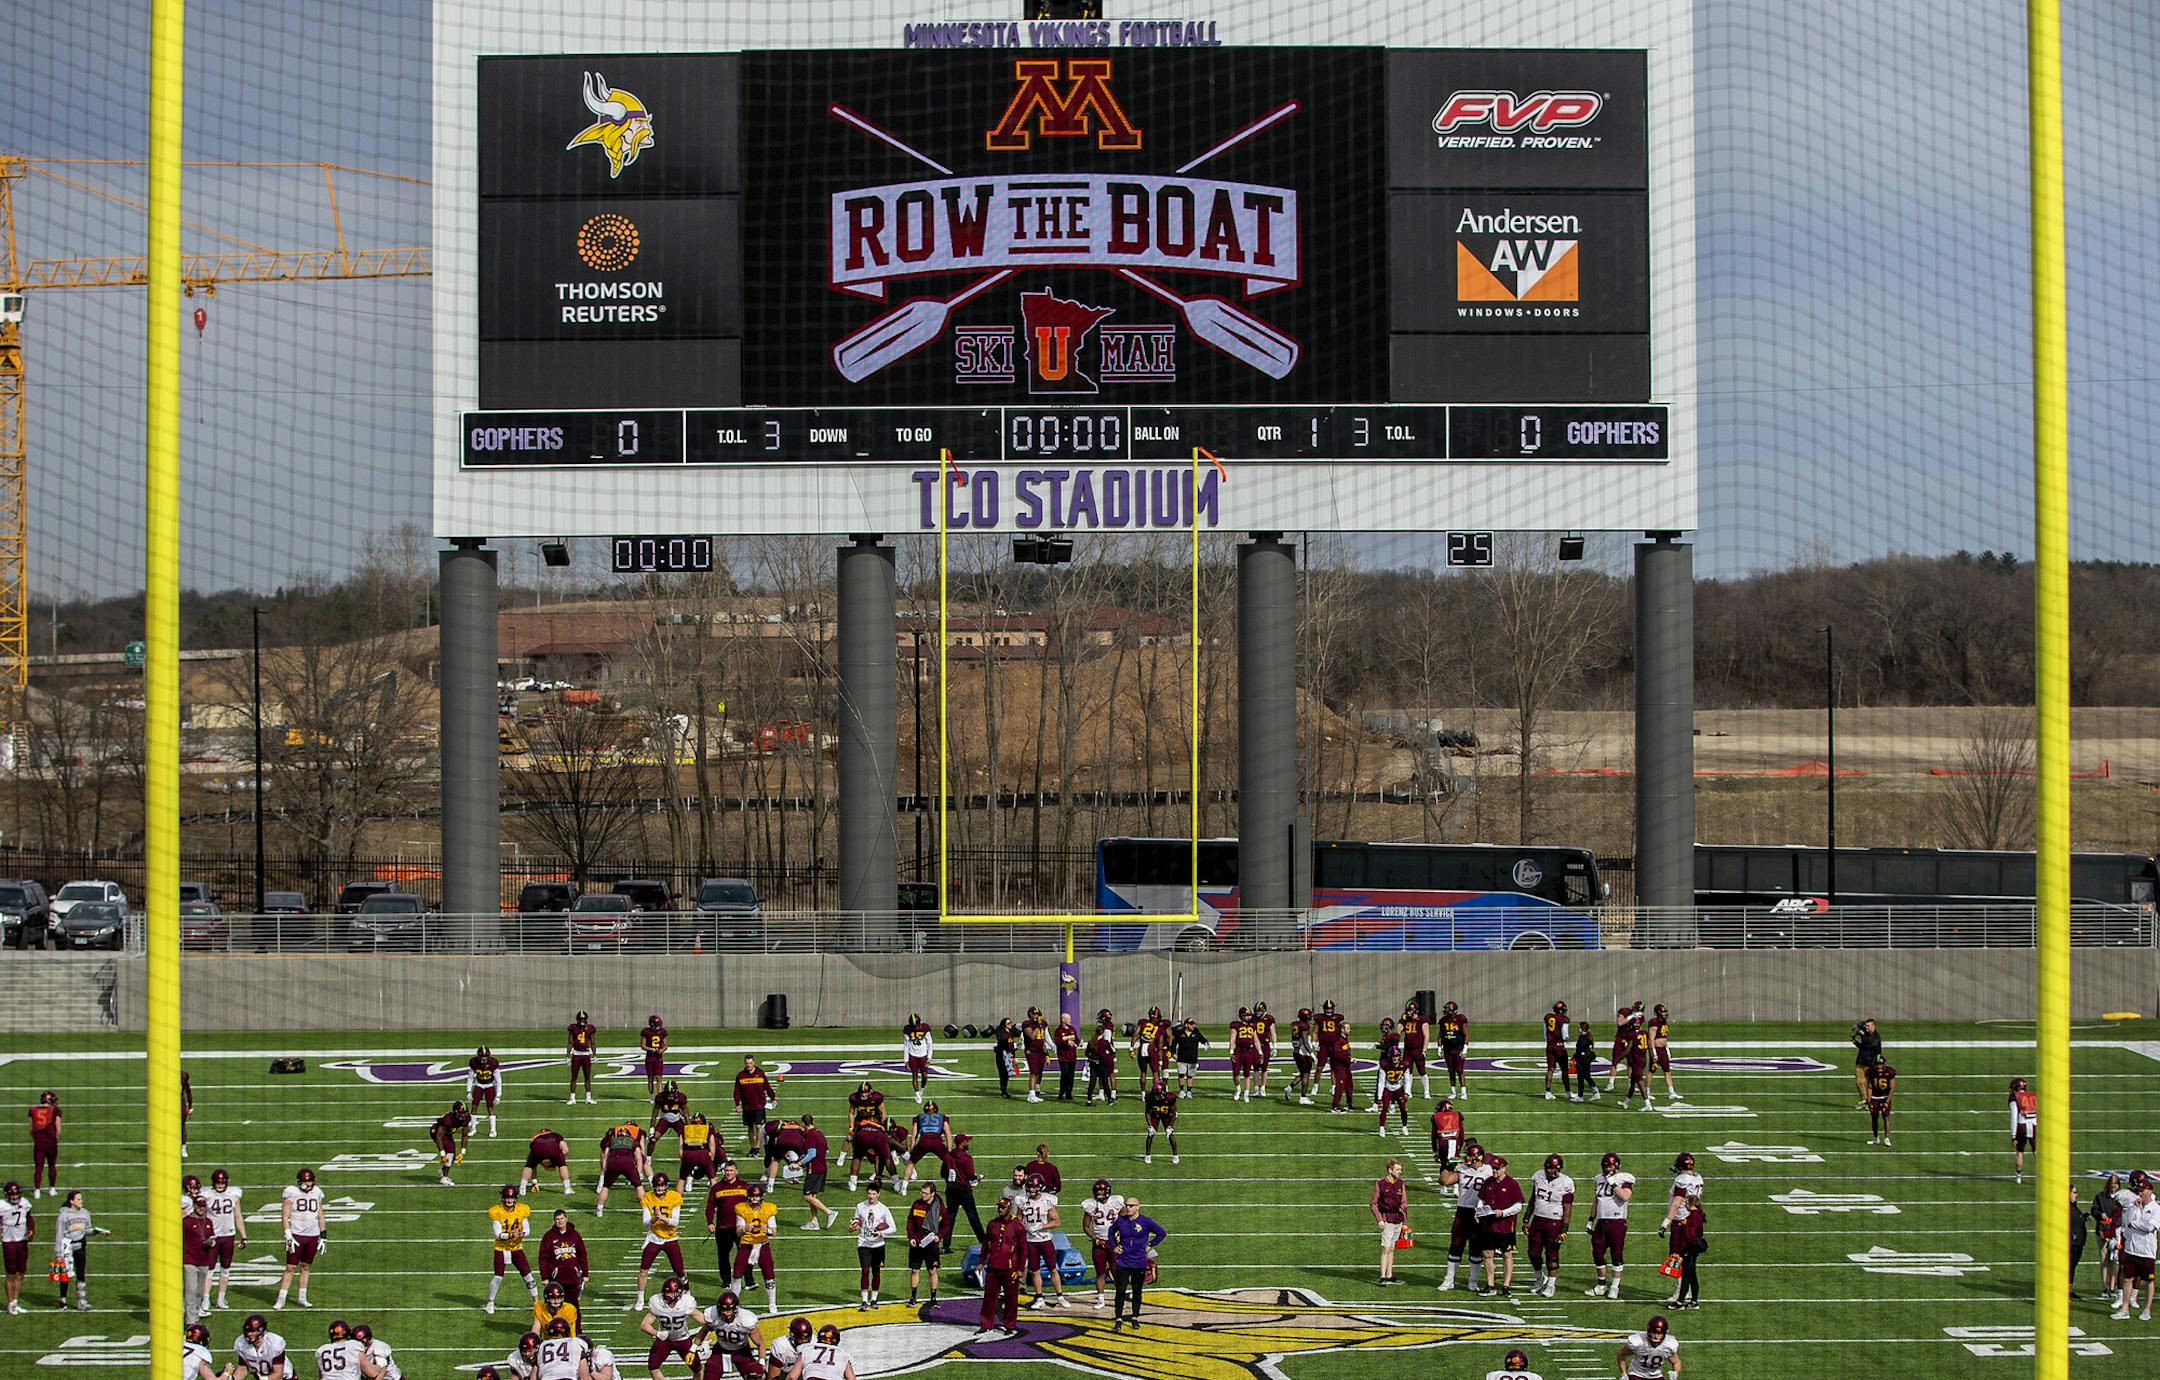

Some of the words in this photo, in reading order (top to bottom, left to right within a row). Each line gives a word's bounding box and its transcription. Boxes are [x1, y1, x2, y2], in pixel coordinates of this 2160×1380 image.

[903, 22, 1021, 48] MINNESOTA
[1027, 21, 1111, 47] VIKINGS
[1119, 20, 1222, 47] FOOTBALL
[986, 60, 1142, 150] M
[1433, 90, 1603, 134] FVP
[1437, 136, 1516, 148] VERIFIED.
[844, 184, 994, 271] ROW
[1008, 196, 1090, 239] THE
[1107, 182, 1284, 267] BOAT
[1456, 208, 1579, 233] Andersen
[555, 282, 663, 300] THOMSON
[1457, 307, 1523, 317] WINDOWS
[1534, 307, 1580, 317] DOORS
[955, 336, 1015, 374] SKI
[1035, 327, 1071, 381] U
[1099, 335, 1176, 373] MAH
[471, 427, 563, 452] GOPHERS
[618, 420, 639, 456] 0
[716, 429, 747, 444] T.O.L.
[765, 420, 780, 450] 3
[810, 428, 847, 444] DOWN
[896, 428, 912, 443] TO
[915, 428, 932, 443] GO
[1012, 415, 1120, 450] 00:00
[1134, 426, 1159, 441] BALL
[1161, 426, 1179, 441] ON
[1257, 426, 1282, 441] QTR
[1354, 417, 1369, 447] 3
[1385, 426, 1415, 440] T.O.L.
[1520, 415, 1541, 450] 0
[1567, 422, 1660, 446] GOPHERS
[911, 470, 1000, 529] TCO
[1015, 469, 1219, 529] STADIUM
[615, 539, 709, 569] 00:00
[1450, 534, 1493, 564] 25
[1409, 907, 1424, 918] BUS
[1769, 898, 1814, 914] ABC
[1141, 1023, 1158, 1039] 21
[1238, 1027, 1254, 1039] 29
[1547, 1017, 1556, 1031] 9
[577, 1031, 586, 1044] 4
[651, 1035, 661, 1047] 2
[1386, 1069, 1404, 1082] 27
[211, 1198, 233, 1215] 42
[296, 1198, 318, 1213] 80
[11, 1211, 21, 1228] 7
[1025, 1206, 1042, 1224] 21
[658, 1315, 685, 1331] 25
[321, 1347, 347, 1373] 65
[542, 1341, 570, 1365] 64
[812, 1345, 836, 1366] 71
